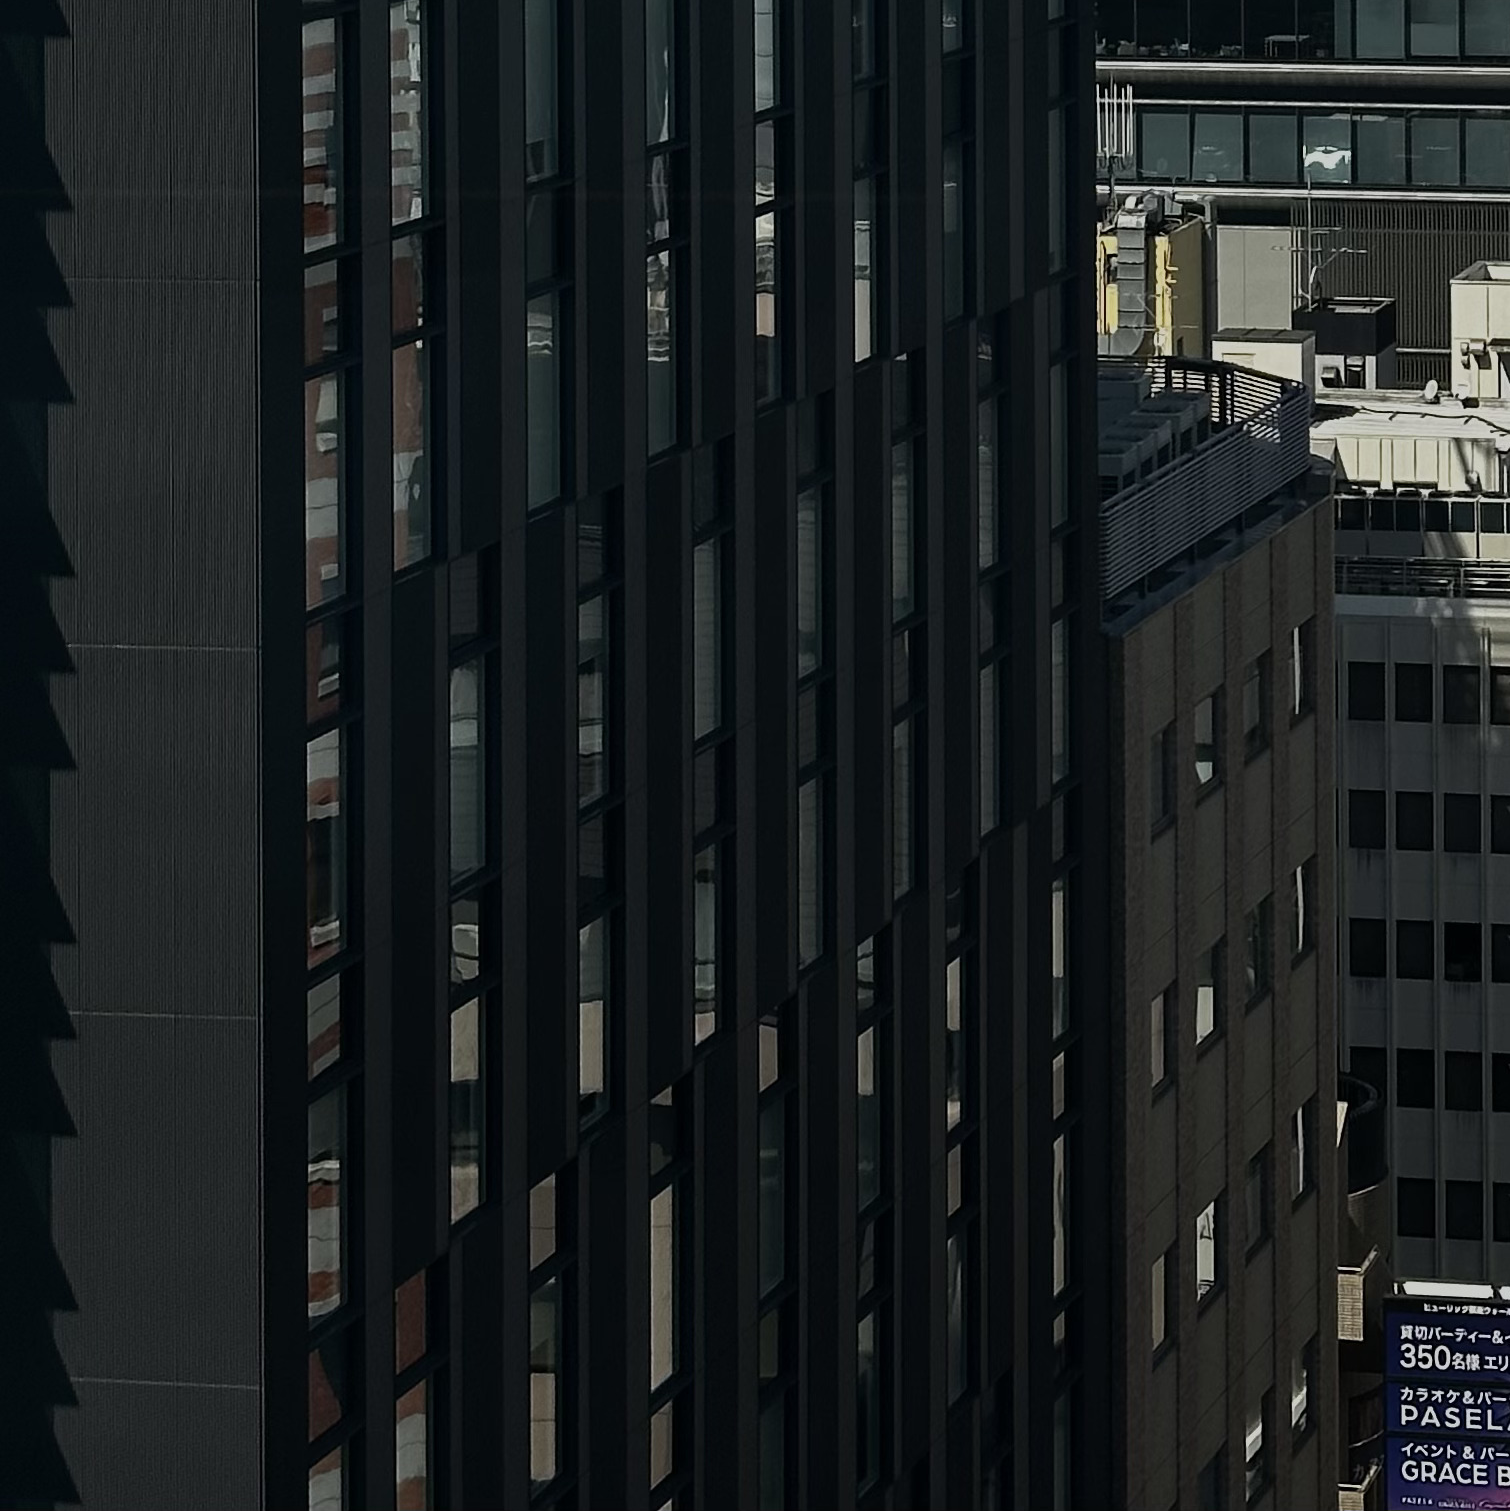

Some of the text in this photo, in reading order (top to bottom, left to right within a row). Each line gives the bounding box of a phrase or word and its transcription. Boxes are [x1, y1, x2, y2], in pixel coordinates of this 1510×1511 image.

[1400, 1343, 1481, 1371] 350名様
[1401, 1442, 1457, 1460] イベント
[1462, 1445, 1475, 1460] &
[1401, 1460, 1489, 1486] GRACE
